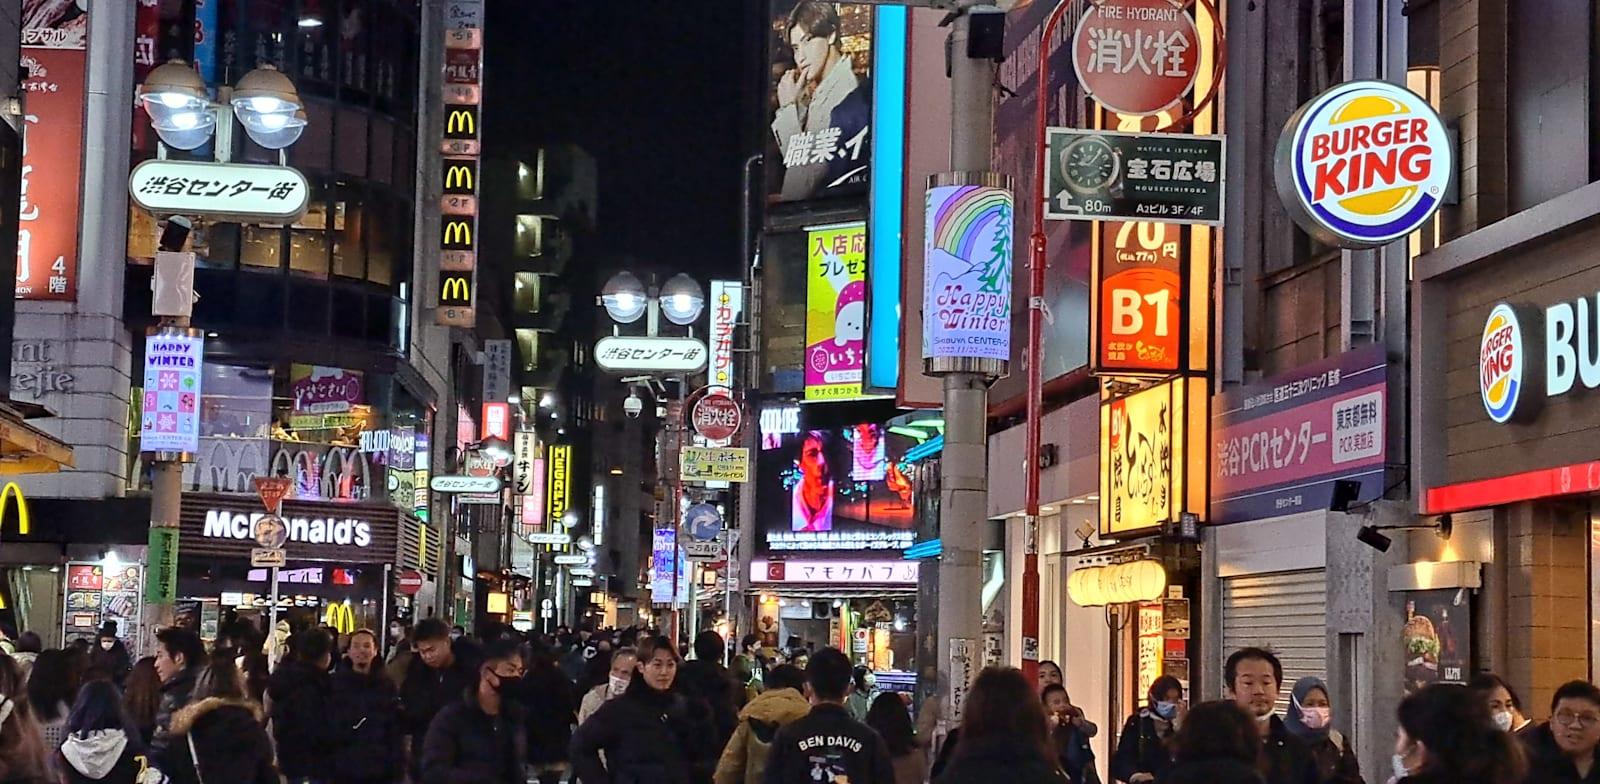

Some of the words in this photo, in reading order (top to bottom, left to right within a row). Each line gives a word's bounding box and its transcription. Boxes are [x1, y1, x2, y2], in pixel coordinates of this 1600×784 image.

[1098, 5, 1123, 19] FIRE
[1126, 7, 1178, 21] HYDRANT
[1086, 26, 1190, 77] 消火栓
[1311, 118, 1428, 163] BURGER
[848, 175, 861, 184] AIR
[1126, 158, 1216, 183] 宝石広場
[1313, 144, 1432, 202] KING
[139, 176, 298, 201] 渋谷センター街
[1084, 199, 1112, 213] 80m
[1135, 203, 1168, 214] A2ビル
[1170, 204, 1204, 216] 3F/4F
[48, 255, 67, 293] 4階
[937, 284, 1006, 315] Happy
[1112, 288, 1169, 337] B1
[153, 343, 191, 353] HAPPY
[716, 306, 733, 370] カラオケ
[148, 355, 194, 367] WINTER
[601, 347, 702, 361] 渋谷センター街
[697, 406, 737, 427] 消火栓
[1336, 399, 1377, 431] 東京都無料
[1216, 421, 1327, 478] 渋谷PCRセンター
[1339, 436, 1354, 453] PCR
[516, 459, 531, 493] 牛タン
[798, 735, 824, 751] BEN
[827, 735, 863, 753] DAVIS
